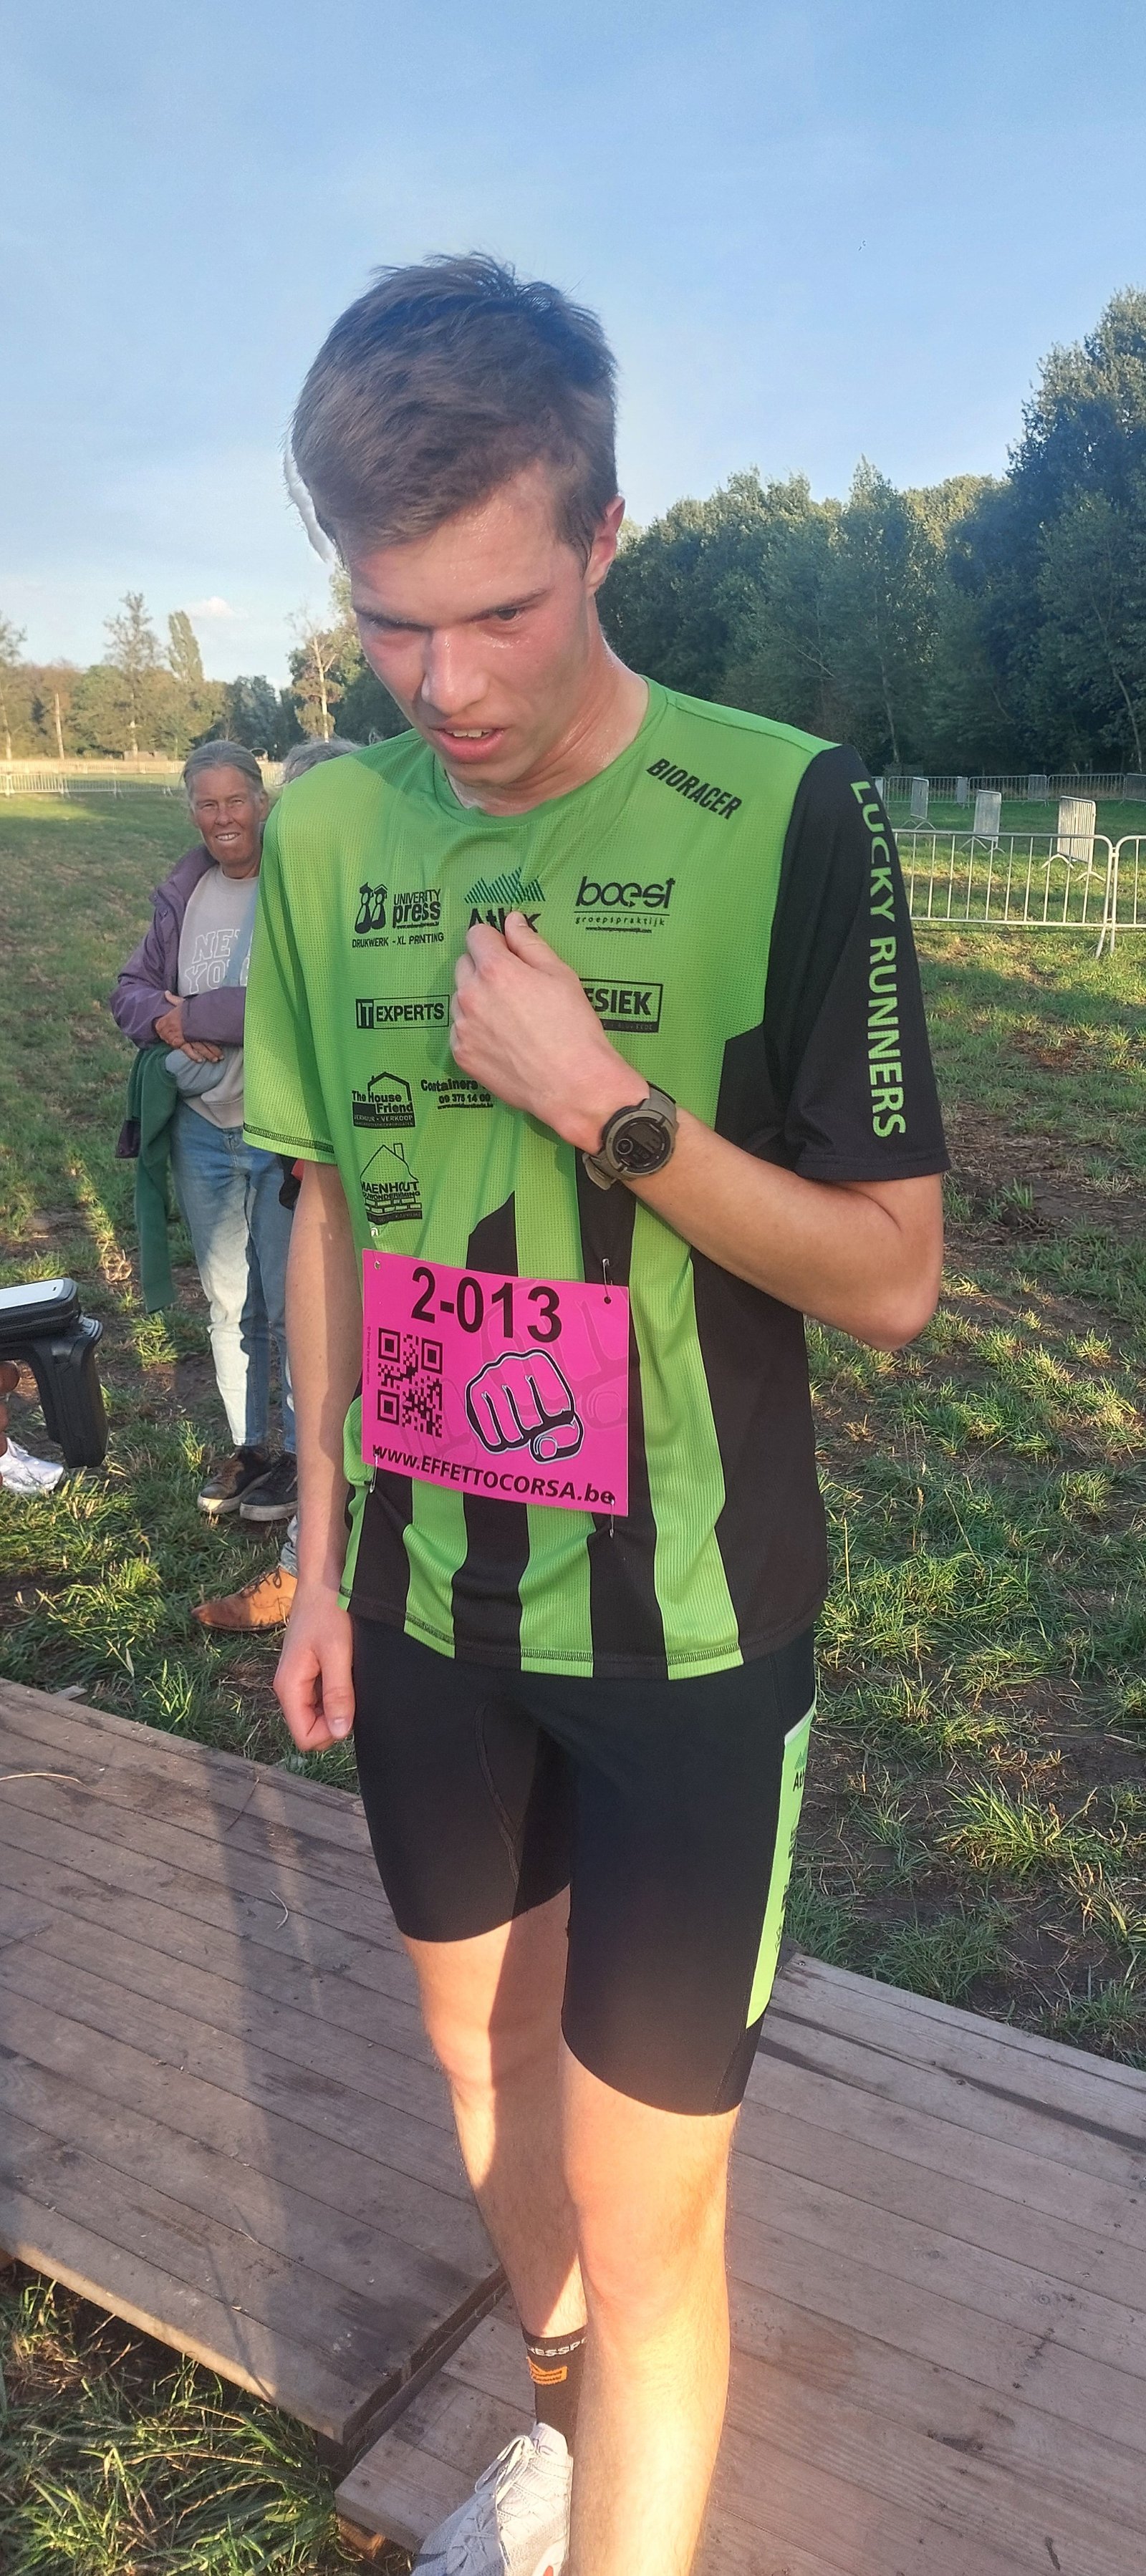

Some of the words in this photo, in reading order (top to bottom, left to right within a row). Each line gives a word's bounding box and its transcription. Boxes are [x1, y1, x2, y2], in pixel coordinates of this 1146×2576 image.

[646, 758, 742, 820] BIORACER
[849, 781, 895, 922] LUCKY
[393, 901, 440, 928] press
[352, 937, 389, 948] DRUKWERK
[376, 1003, 444, 1022] EXPERTS
[867, 936, 906, 1137] RUNNERS
[352, 1090, 366, 1101] The
[368, 1091, 403, 1102] House
[377, 1102, 413, 1113] Friend
[410, 1266, 562, 1343] 2-013
[372, 1444, 616, 1505] www.EFFETTOCORSA.be
